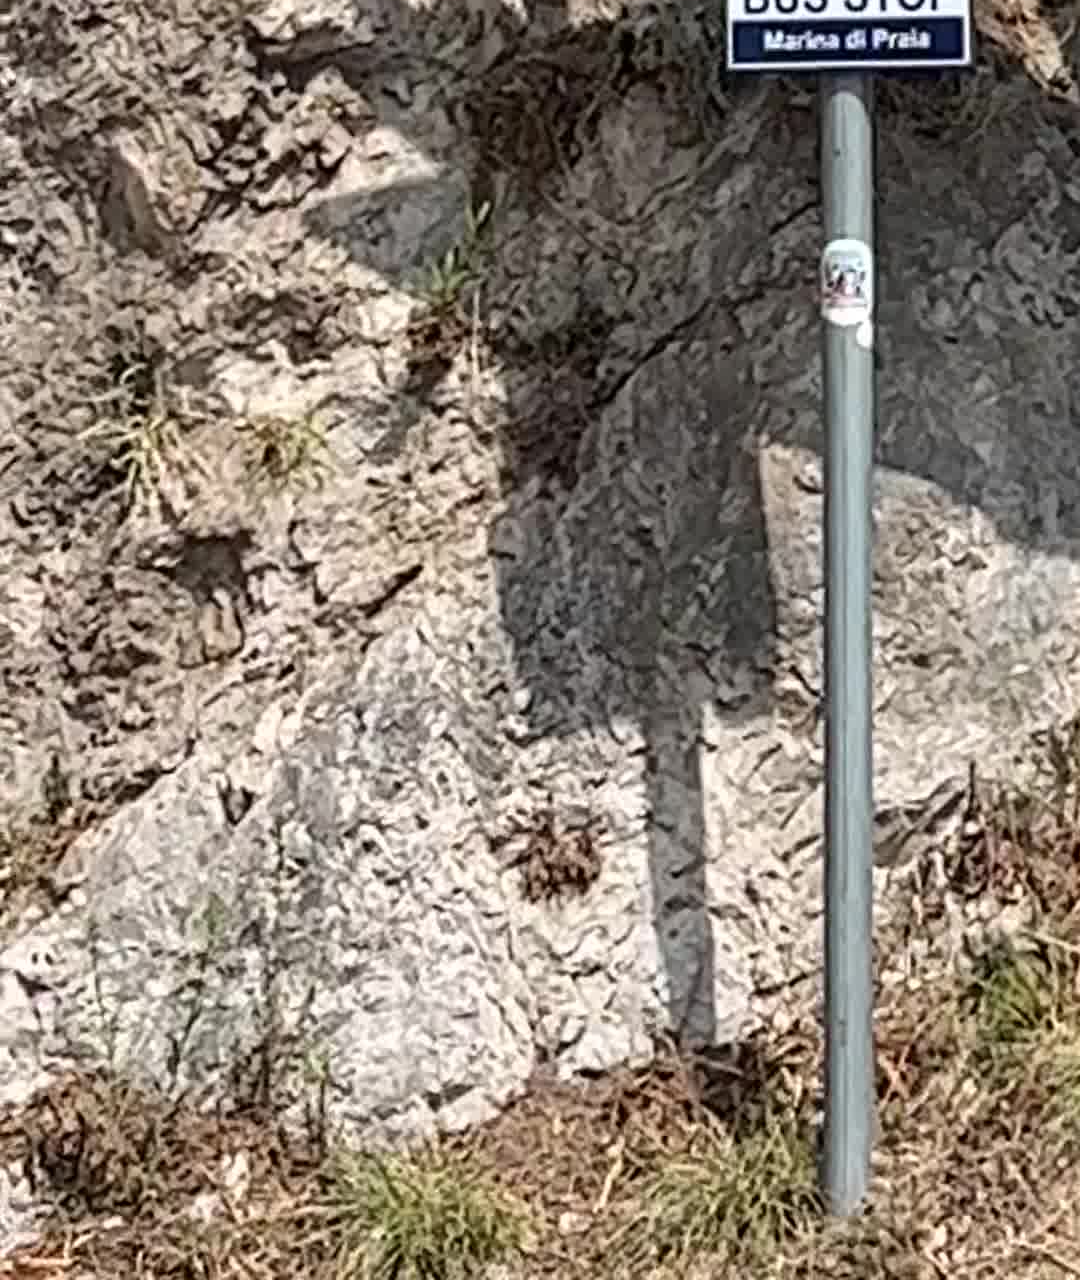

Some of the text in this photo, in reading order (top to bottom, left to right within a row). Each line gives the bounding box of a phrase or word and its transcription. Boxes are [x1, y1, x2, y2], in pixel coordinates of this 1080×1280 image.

[763, 27, 931, 51] Marina di Praia
